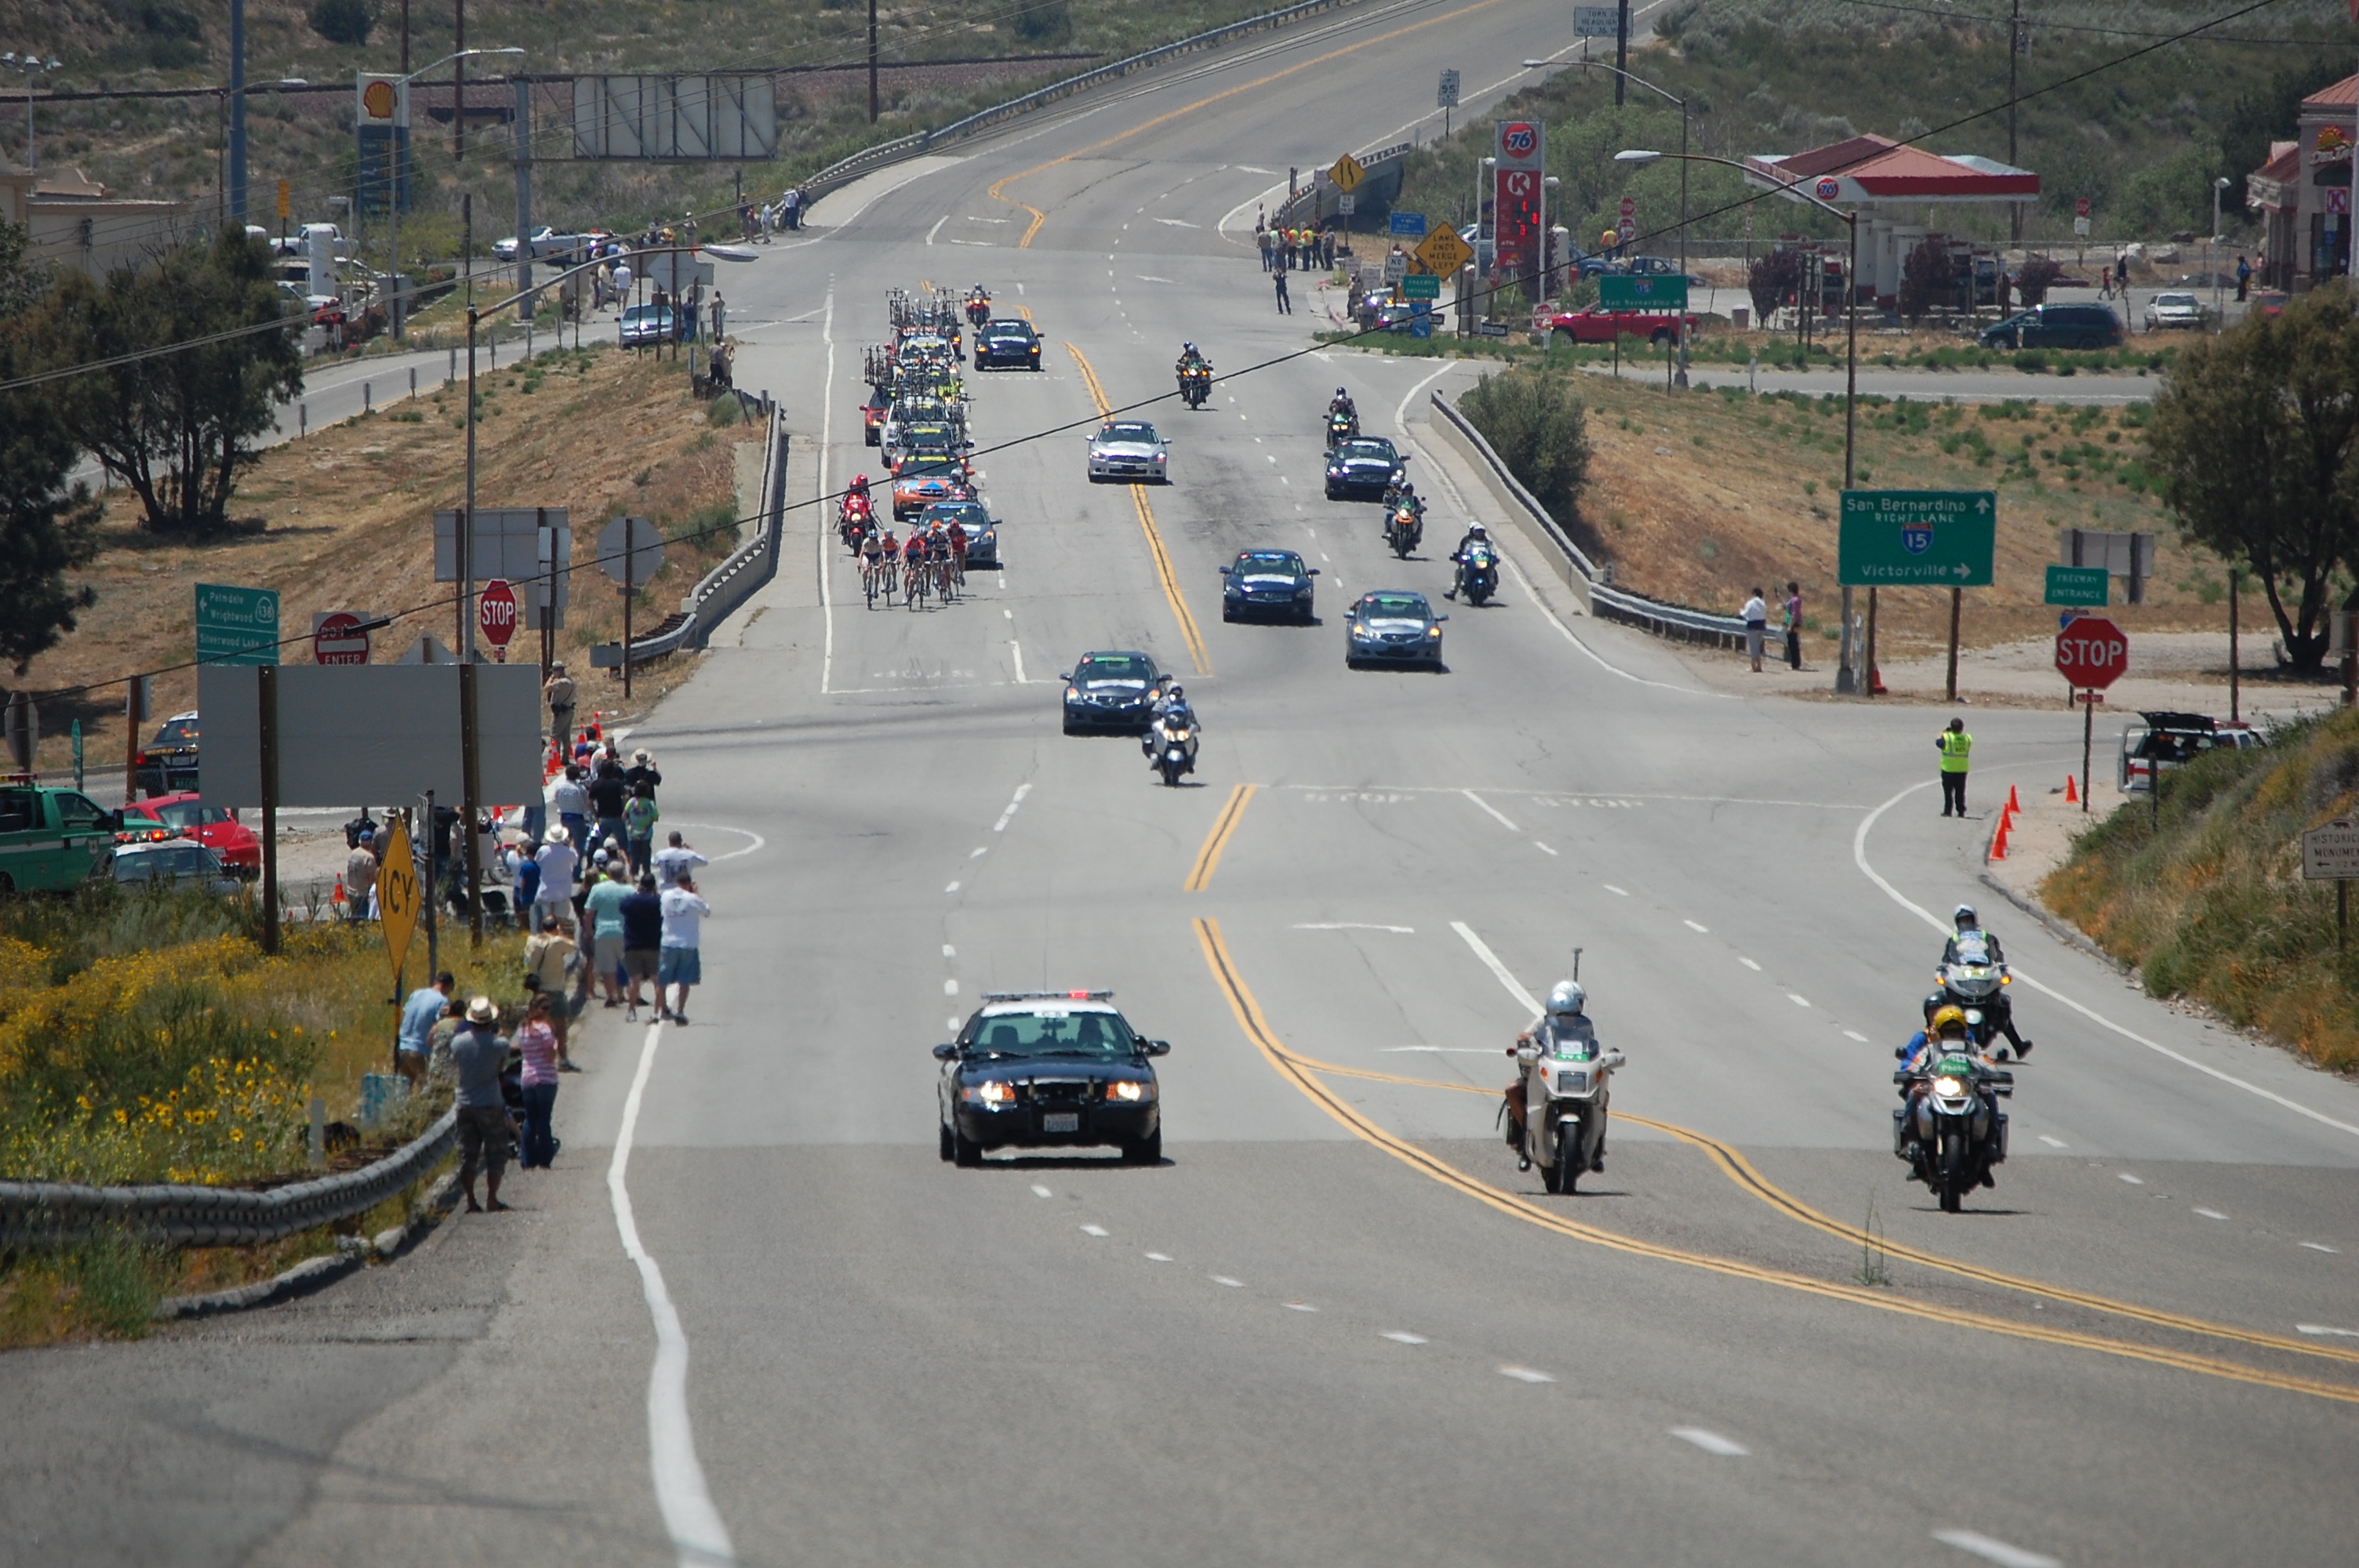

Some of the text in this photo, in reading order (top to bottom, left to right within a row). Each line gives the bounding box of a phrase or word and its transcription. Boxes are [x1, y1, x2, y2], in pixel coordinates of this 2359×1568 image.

[1507, 129, 1532, 151] 76
[1820, 182, 1836, 196] 76
[1433, 261, 1454, 270] LEFT
[1846, 498, 1967, 513] San Bernardino
[1874, 512, 1955, 523] RIGHT LANE
[1906, 533, 1928, 549] 15
[1861, 564, 1948, 577] Victorville
[2055, 574, 2099, 584] FREEWAY
[209, 592, 244, 604] Palmdale
[2051, 589, 2103, 600] ENTRANCE
[211, 605, 273, 623] Wrightwood 138
[482, 601, 514, 626] STOP
[199, 633, 260, 648] Silverwood Lake
[324, 653, 362, 665] ENTER
[2058, 638, 2124, 667] STOP
[383, 867, 413, 917] ICY
[1940, 1064, 1968, 1073] Photo
